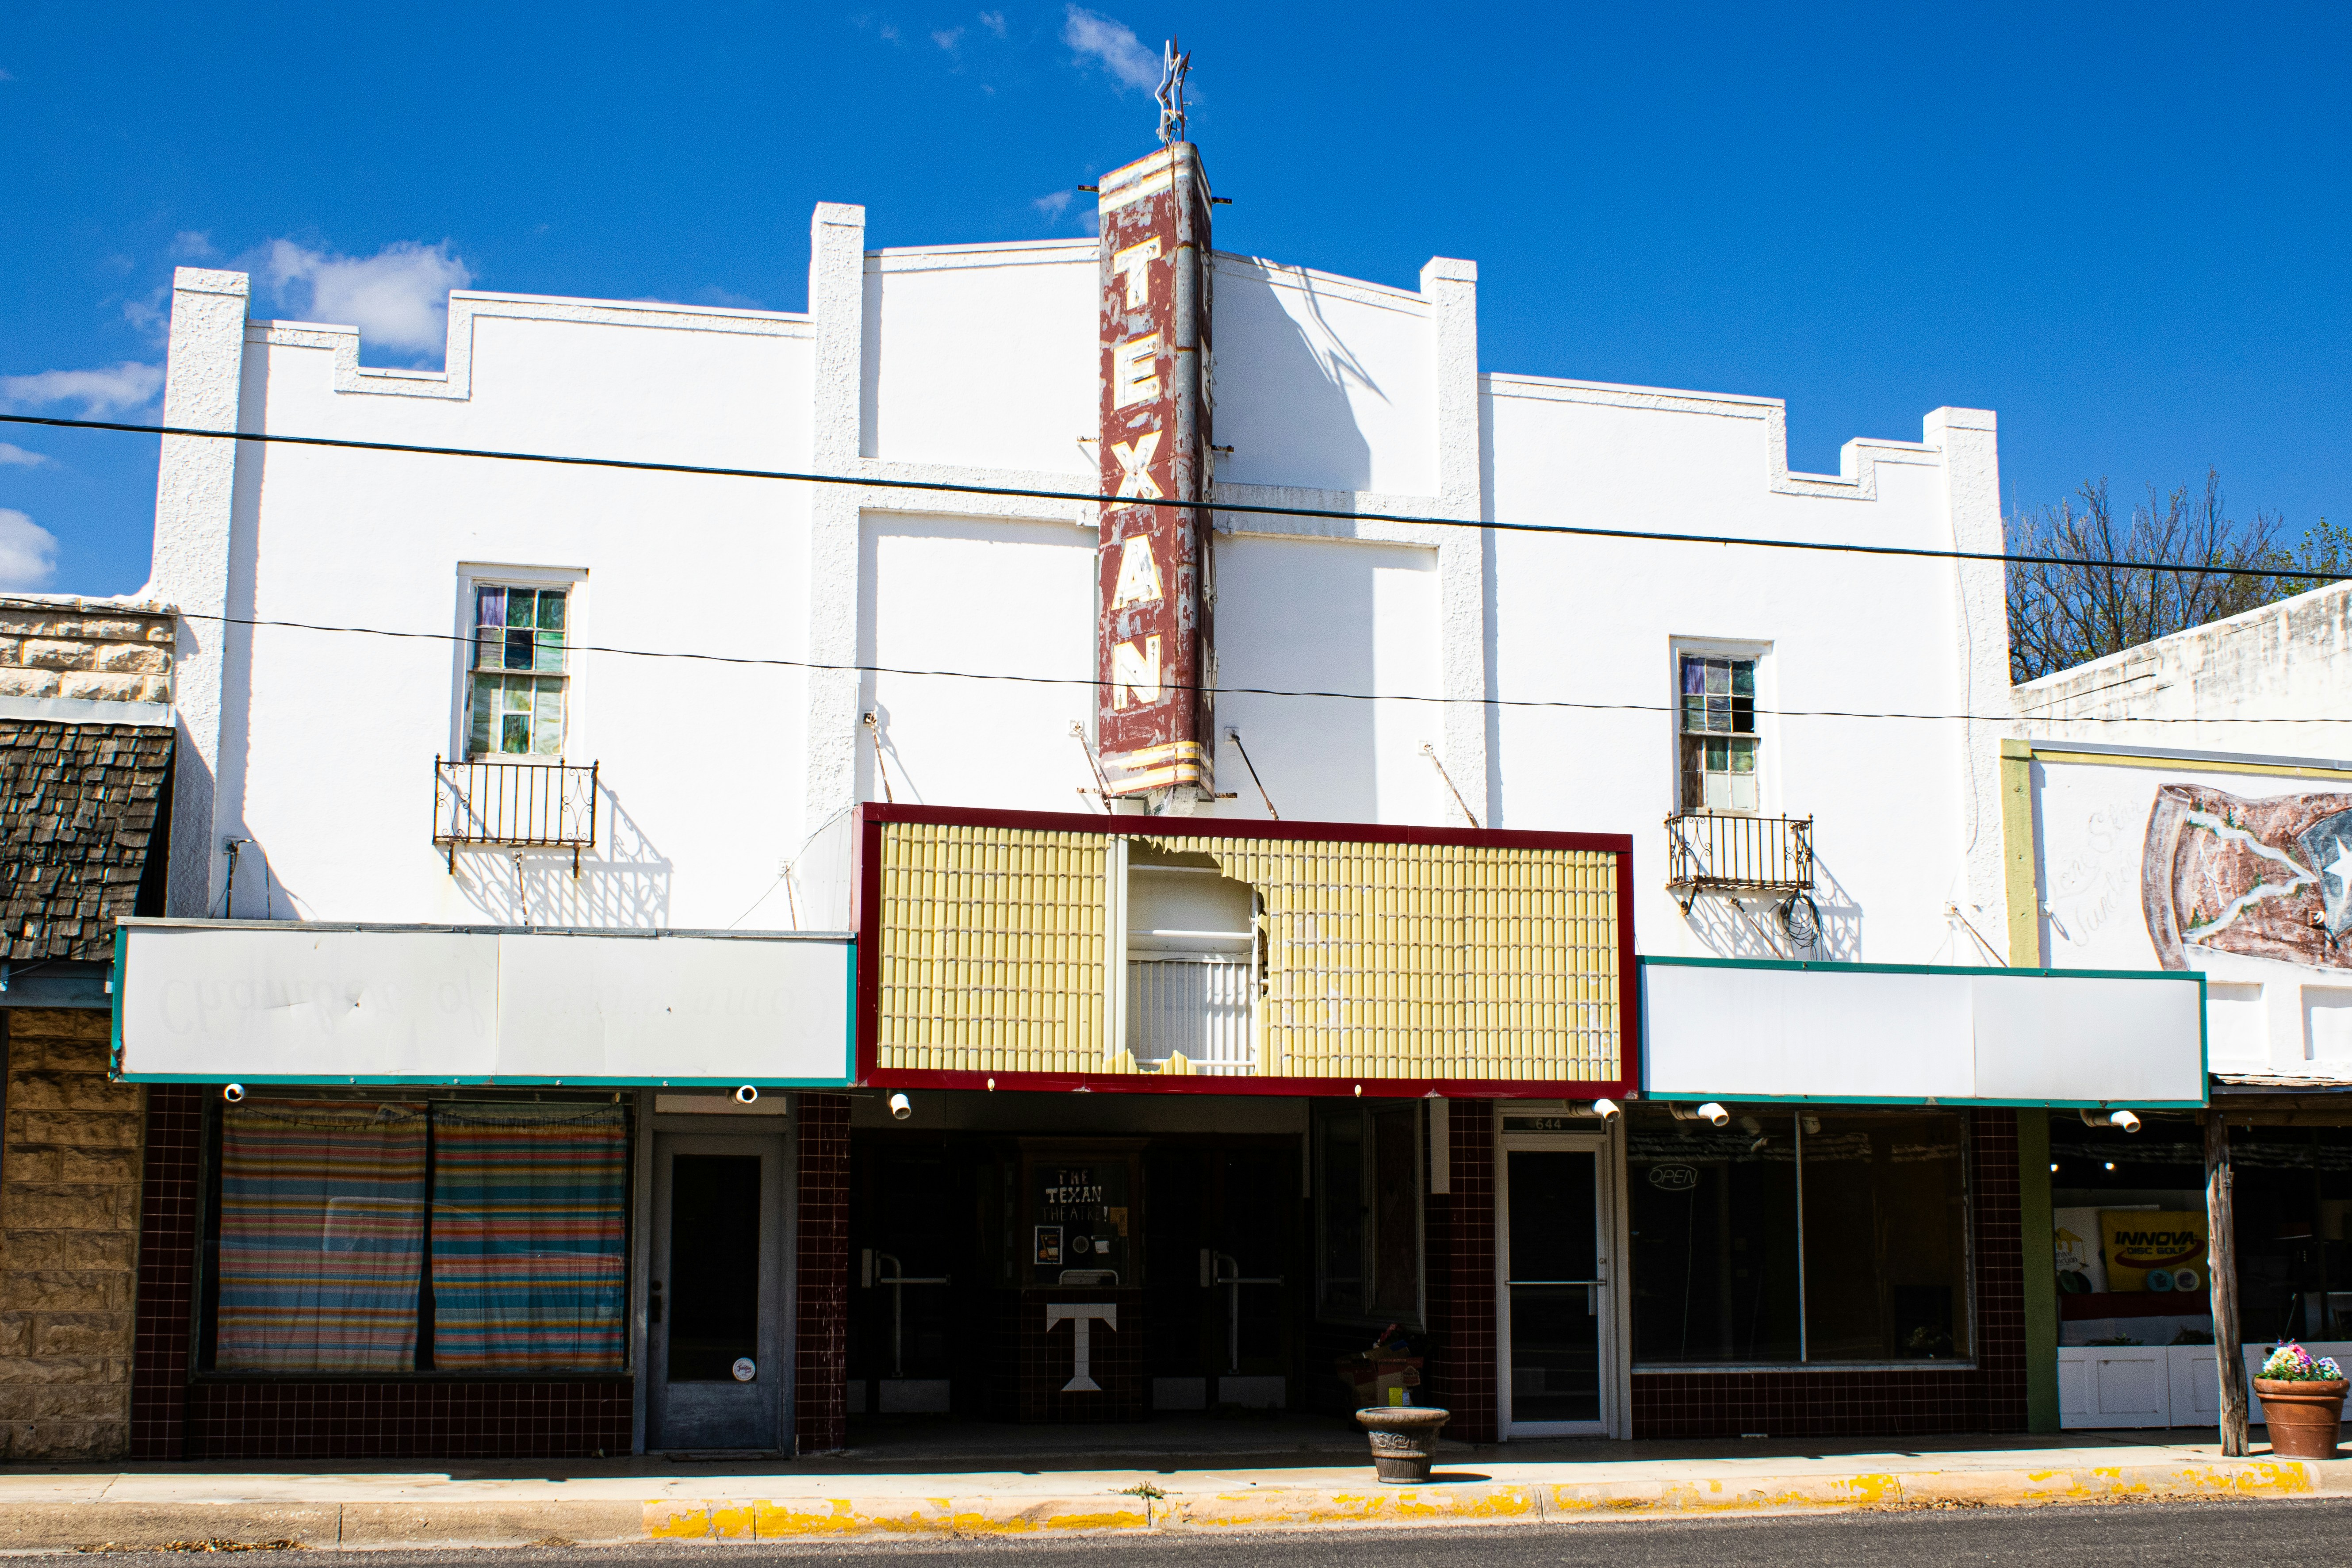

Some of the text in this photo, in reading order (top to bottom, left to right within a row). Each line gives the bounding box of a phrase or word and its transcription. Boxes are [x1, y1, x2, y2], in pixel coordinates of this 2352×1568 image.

[1110, 235, 1163, 711] TEXAN
[1536, 1118, 1562, 1130] 644
[1056, 1169, 1089, 1185] THE
[1649, 1169, 1698, 1184] OPEN
[1045, 1185, 1102, 1204] TEXAN
[2115, 1231, 2195, 1245] INNOVA
[2156, 1246, 2186, 1255] GOLF
[1046, 1303, 1116, 1391] T
